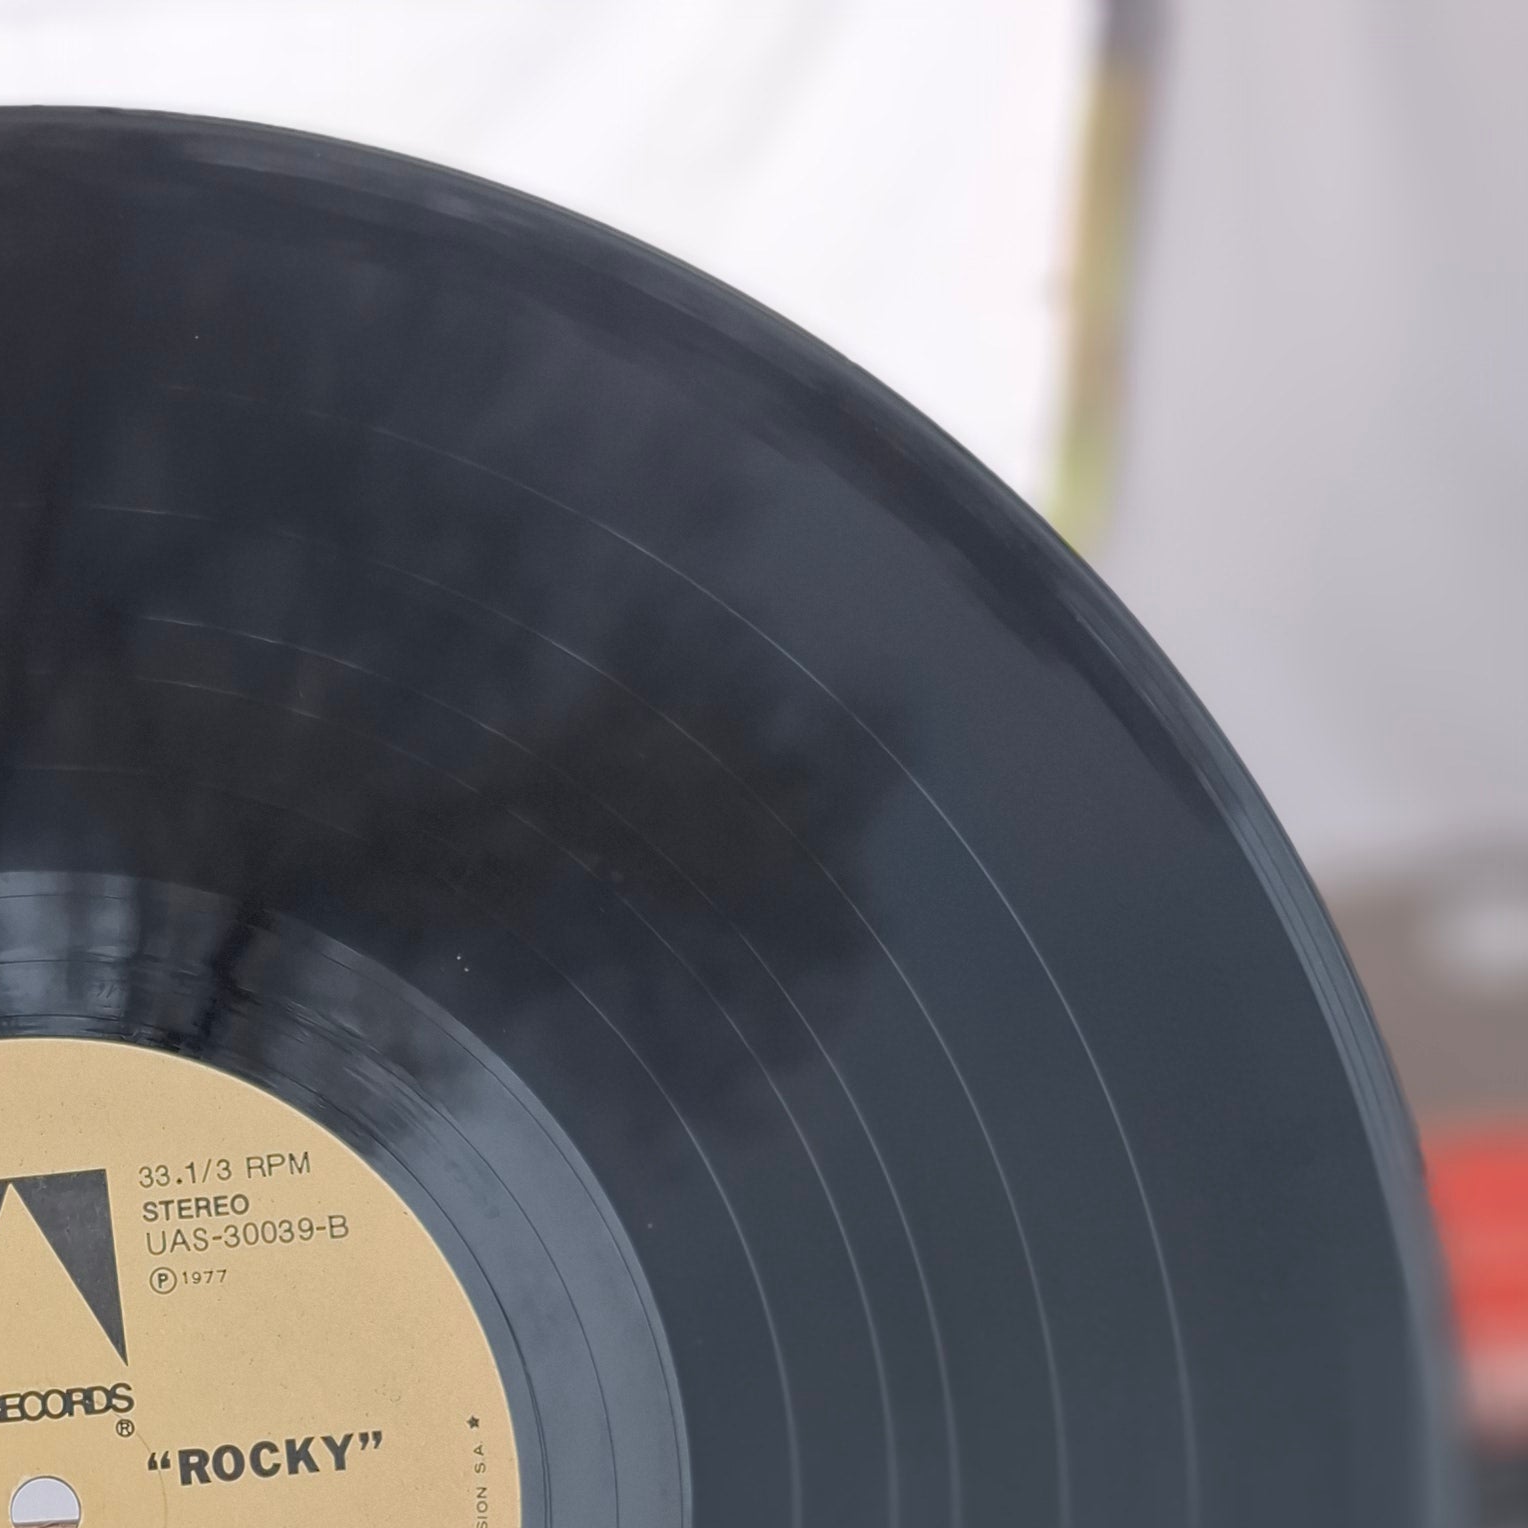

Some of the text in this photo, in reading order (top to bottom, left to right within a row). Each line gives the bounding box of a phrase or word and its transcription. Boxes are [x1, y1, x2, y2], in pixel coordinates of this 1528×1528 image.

[138, 1152, 311, 1188] 33.1/3 RPM
[143, 1194, 249, 1222] STEREO
[146, 1214, 349, 1255] UAS-30039-B
